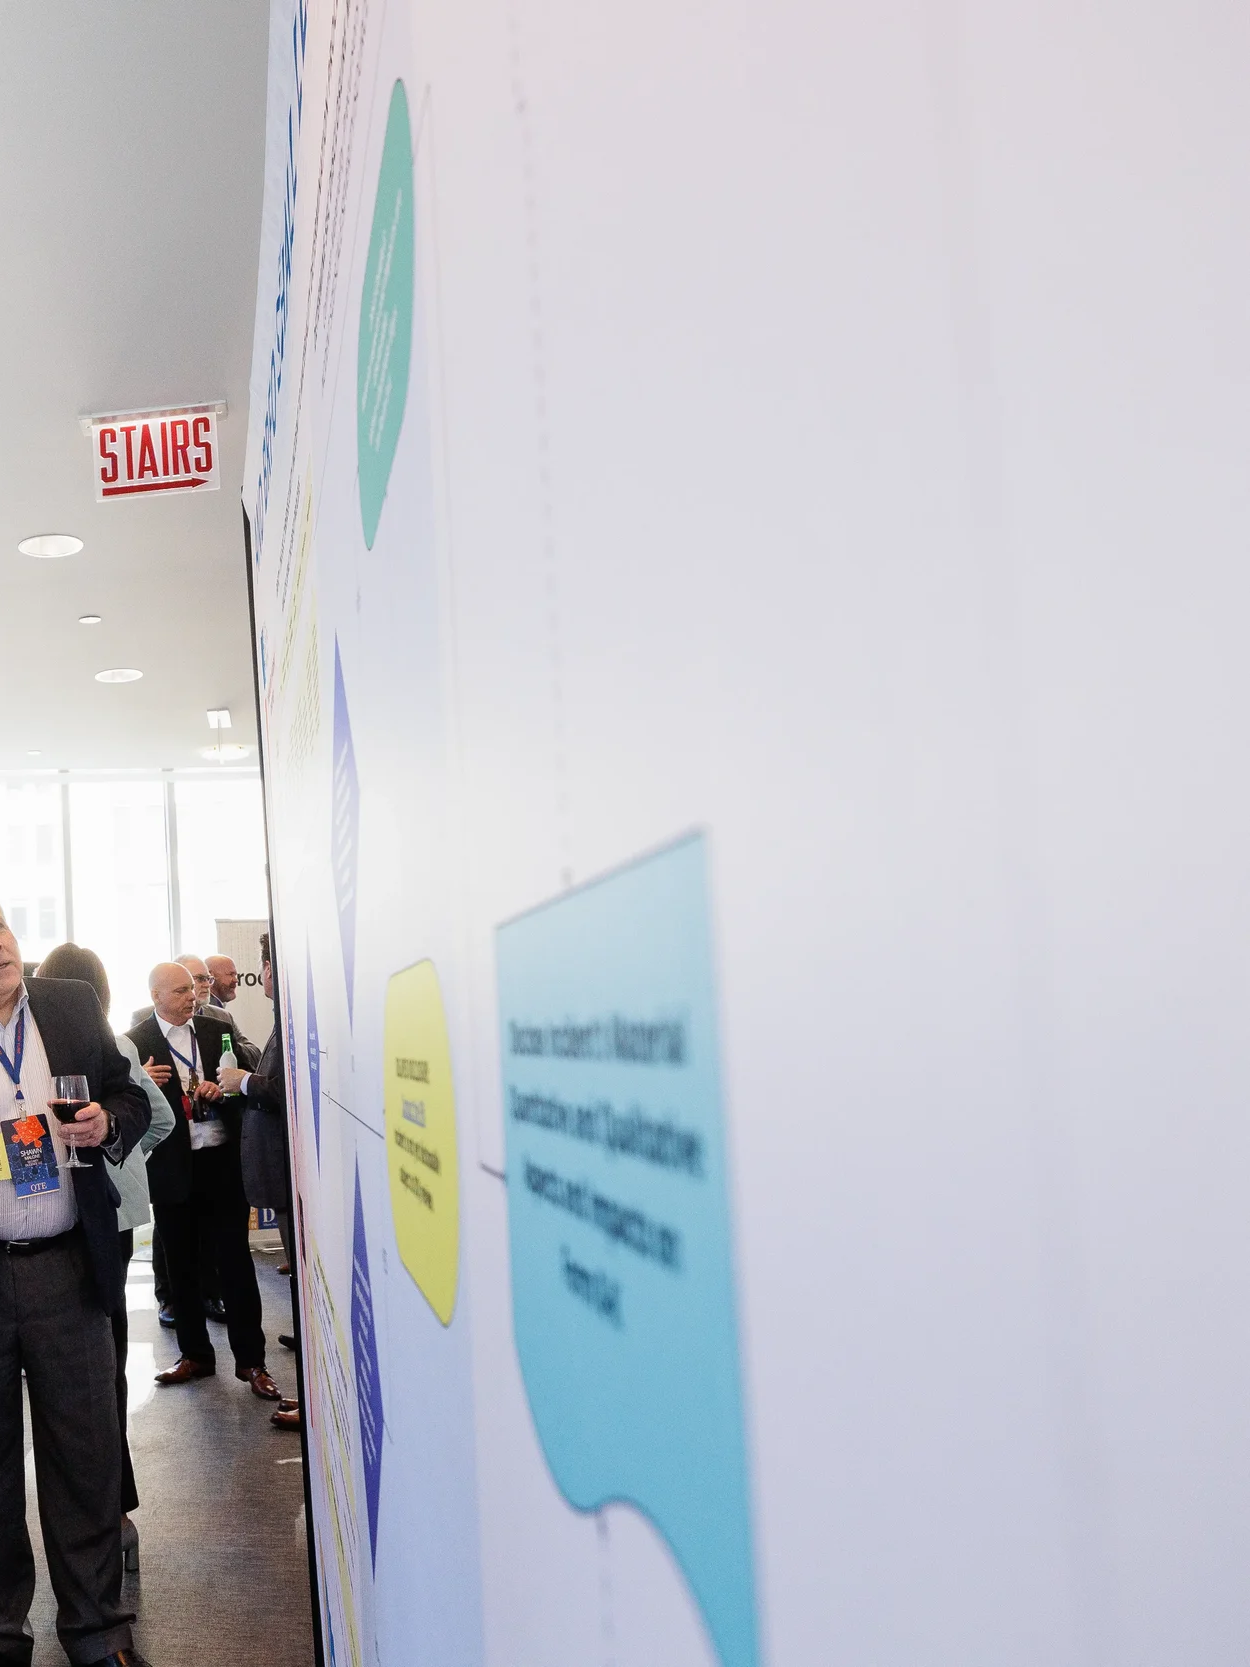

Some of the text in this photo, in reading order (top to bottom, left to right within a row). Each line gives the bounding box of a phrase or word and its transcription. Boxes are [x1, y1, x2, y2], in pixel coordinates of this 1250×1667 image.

[100, 417, 212, 483] STAIRS
[20, 1147, 42, 1157] SHAWN
[31, 1182, 47, 1192] QTE
